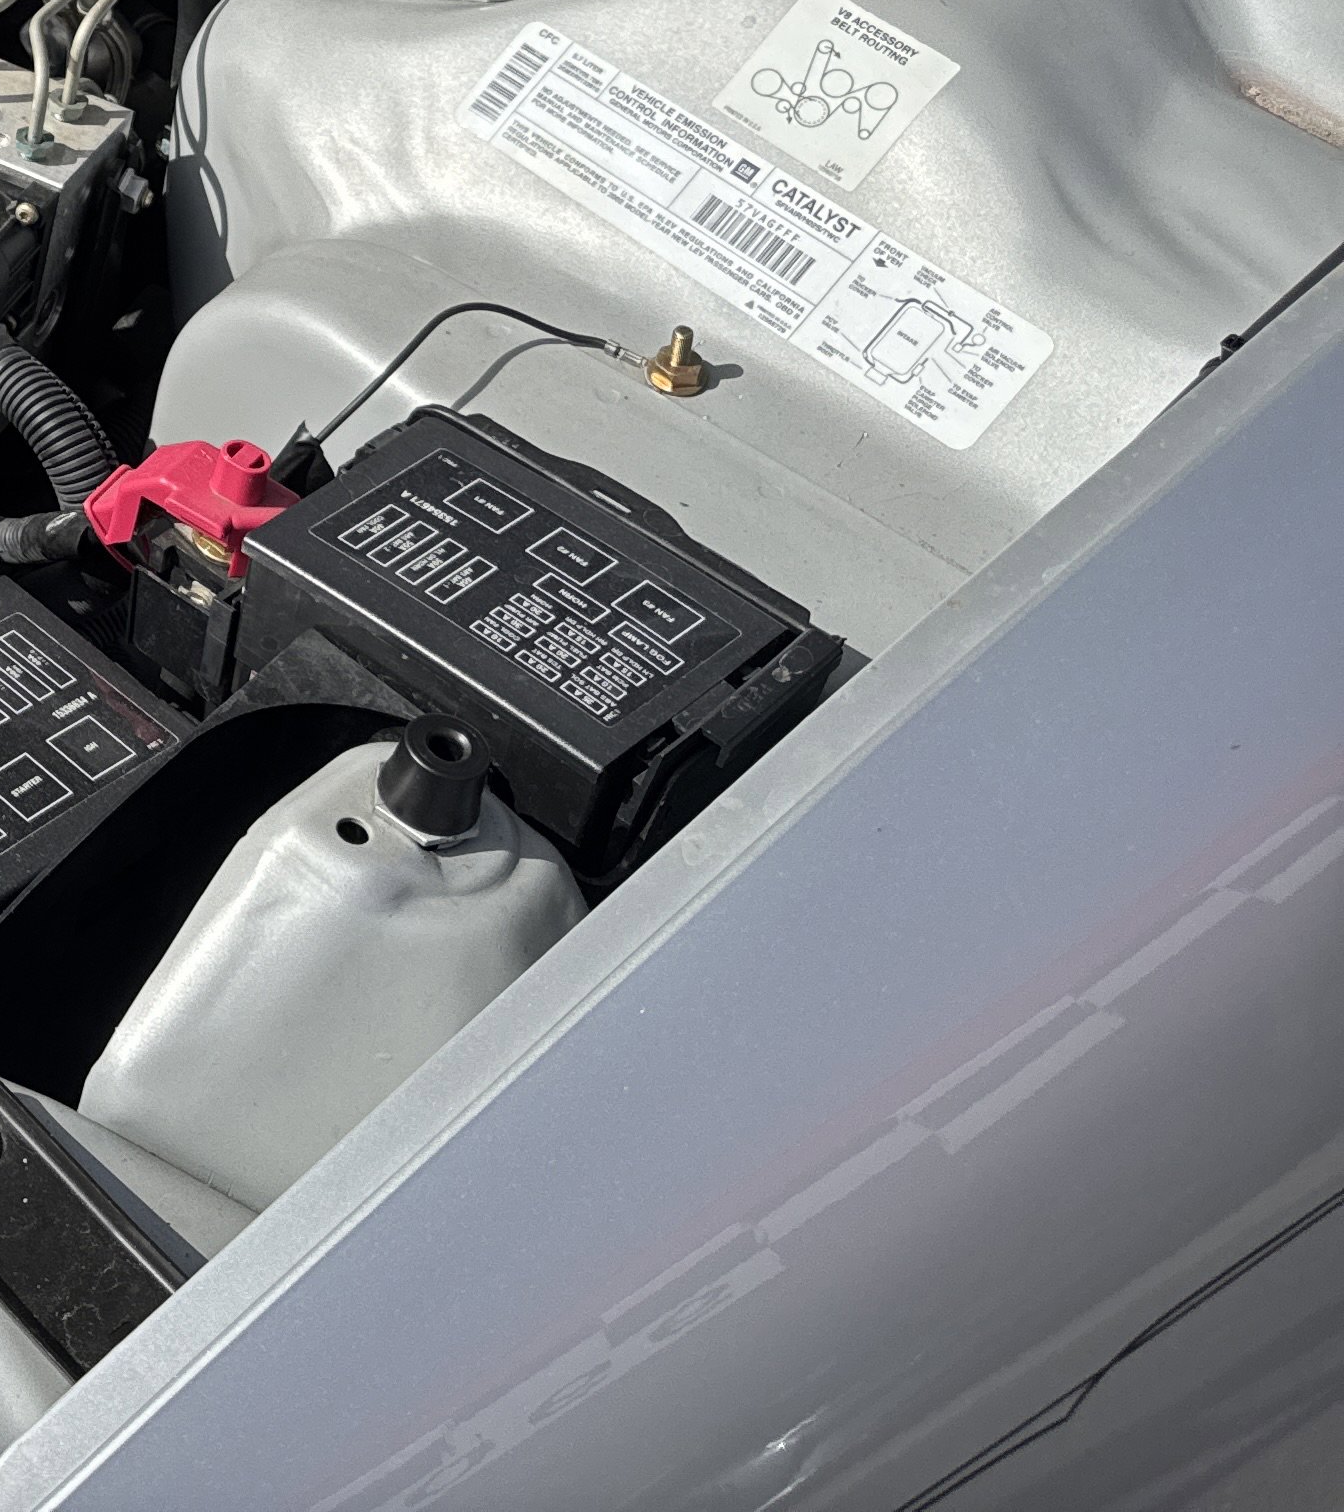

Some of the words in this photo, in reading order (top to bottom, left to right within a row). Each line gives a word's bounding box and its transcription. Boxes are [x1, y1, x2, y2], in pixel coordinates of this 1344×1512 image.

[850, 15, 919, 59] ACCESSORY
[857, 32, 909, 66] ROUTING
[535, 91, 566, 113] MANUAL
[582, 121, 636, 158] MAINTENANCE
[634, 155, 677, 184] SCHEDULE
[550, 92, 603, 127] ADJUSTMENTS
[648, 154, 681, 177] SERVICE
[606, 85, 660, 121] CONTROL
[659, 117, 735, 168] INFORMATION
[607, 97, 642, 122] GENERAL
[640, 118, 672, 140] MOTORS
[669, 136, 725, 173] CORPORATION
[628, 85, 674, 117] VEHICLE
[673, 113, 728, 150] EMISSION
[505, 125, 555, 159] REGULATIONS
[553, 156, 598, 187] APPLICABLE
[703, 254, 750, 286] PASSENGER
[529, 131, 563, 155] VEHICLE
[562, 152, 607, 184] CONFORMS
[676, 227, 734, 267] REGULATIONS
[754, 277, 807, 313] CALIFORNIA
[768, 177, 863, 240] CATALYST
[877, 240, 909, 262] FRONT
[619, 629, 652, 651] LAMP
[9, 774, 43, 797] STARTER
